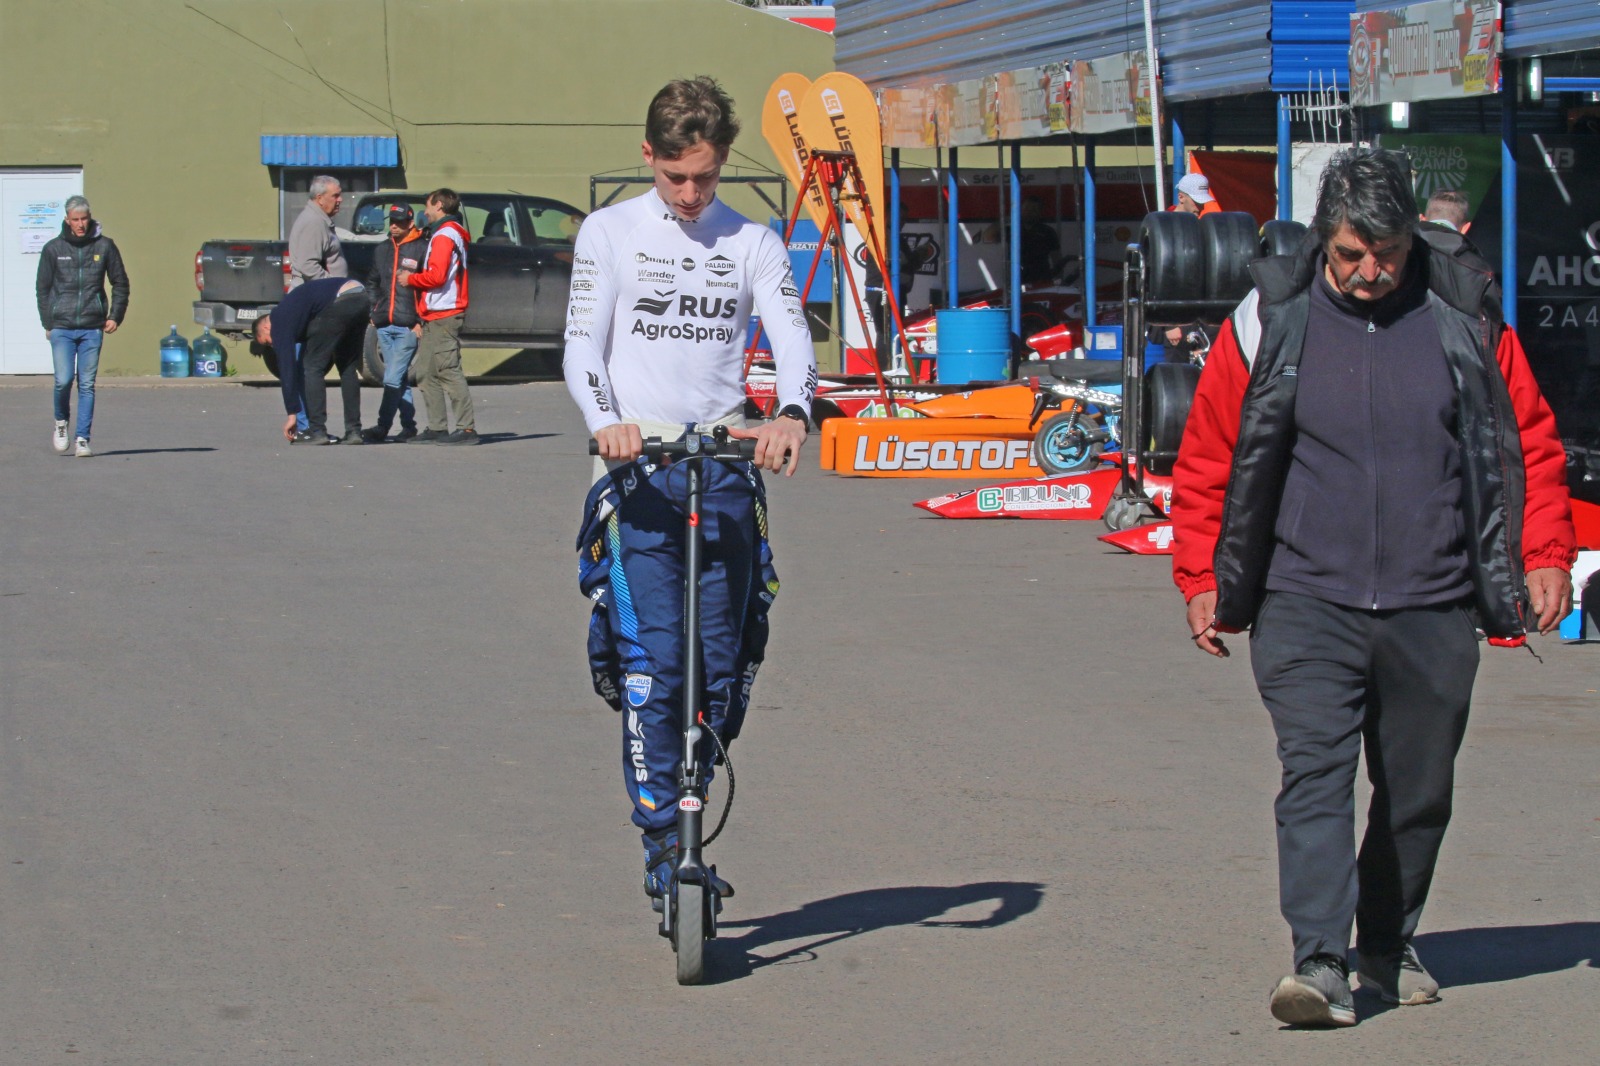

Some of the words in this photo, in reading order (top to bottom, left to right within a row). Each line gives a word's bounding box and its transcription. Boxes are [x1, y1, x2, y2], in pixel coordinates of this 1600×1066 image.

[1412, 157, 1468, 170] CAMPO
[637, 269, 675, 280] Wander
[679, 294, 738, 318] RUS
[631, 318, 733, 344] AgroSpray
[1005, 485, 1090, 503] BRUNO
[601, 675, 619, 701] RUS
[635, 678, 651, 686] RUS
[631, 739, 648, 782] RUS
